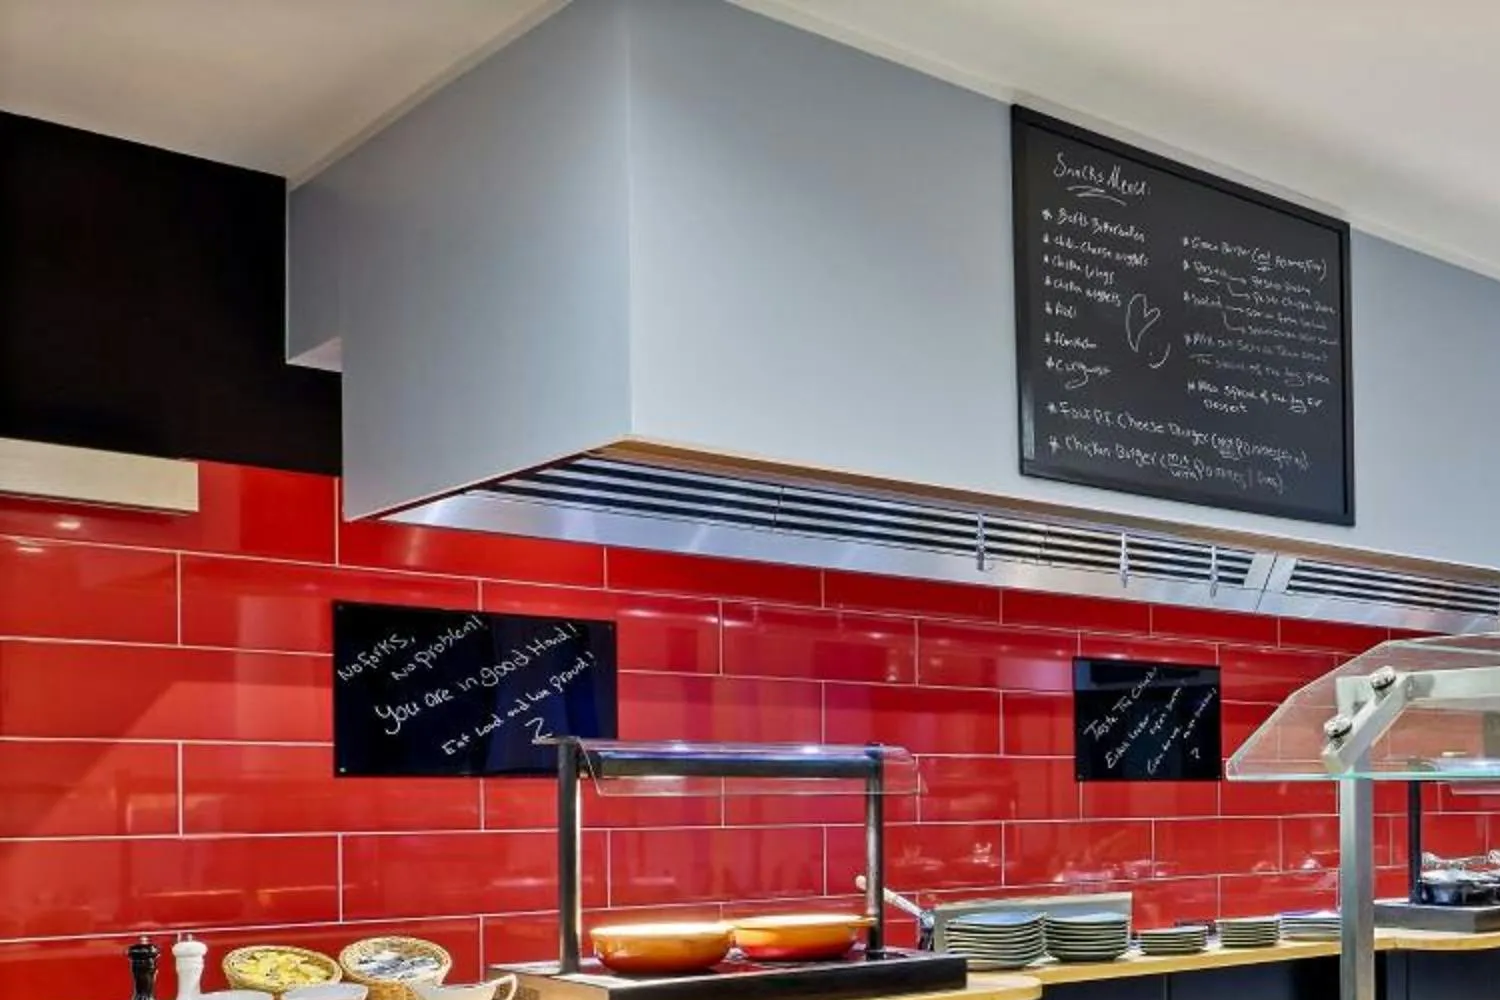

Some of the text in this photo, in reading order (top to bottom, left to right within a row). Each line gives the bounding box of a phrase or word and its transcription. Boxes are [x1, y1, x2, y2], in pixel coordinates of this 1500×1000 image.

[1065, 434, 1111, 459] Chicken
[424, 688, 454, 708] are
[456, 676, 480, 692] in
[480, 649, 530, 688] good
[441, 734, 472, 756] Eat
